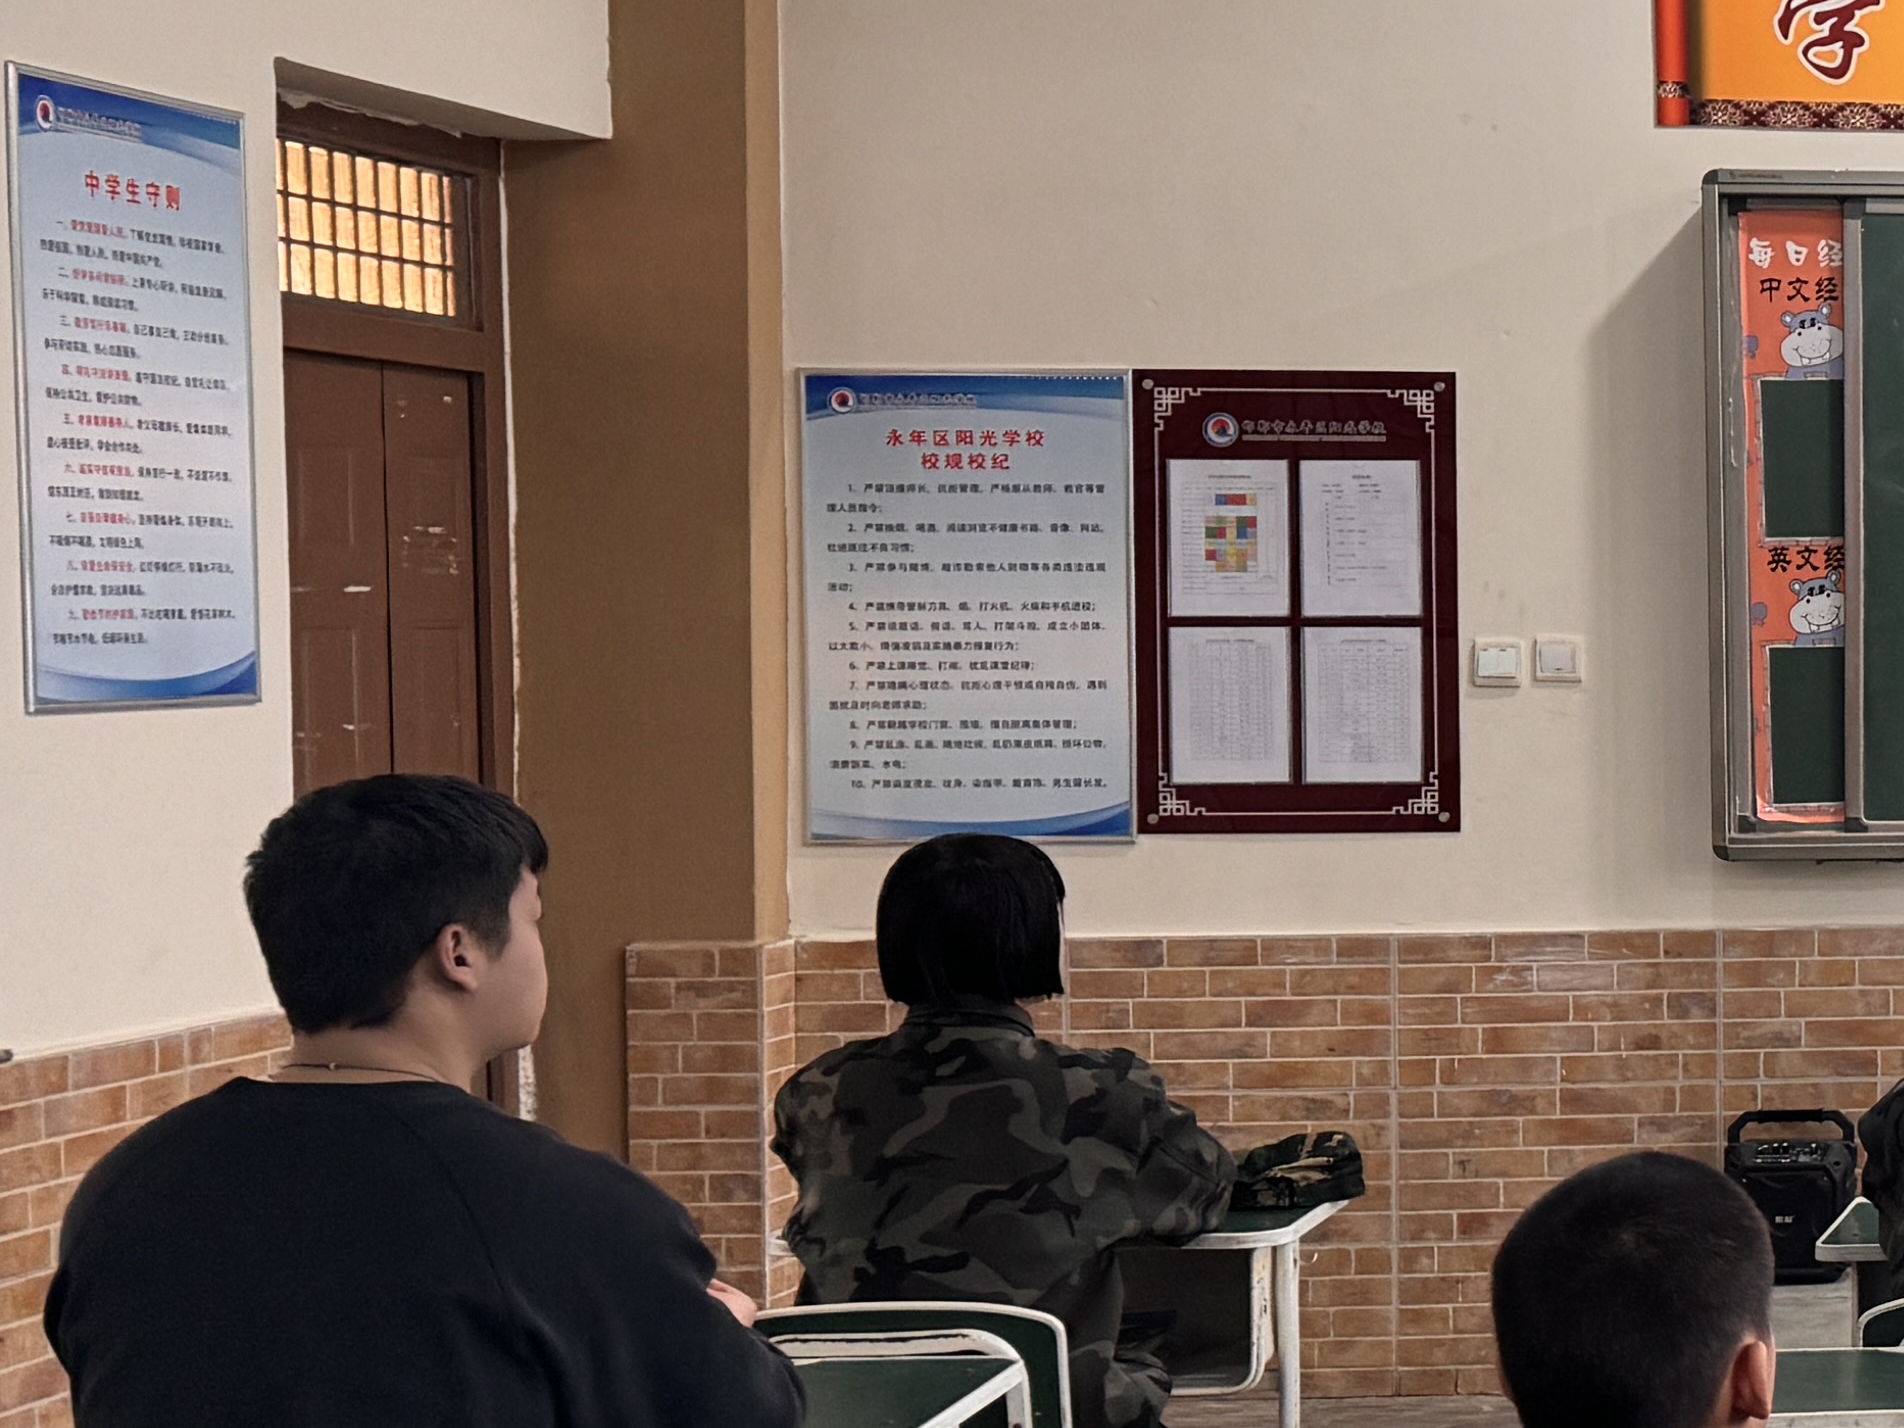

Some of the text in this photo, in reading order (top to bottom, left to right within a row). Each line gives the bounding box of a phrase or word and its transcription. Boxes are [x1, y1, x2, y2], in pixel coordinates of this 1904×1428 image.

[84, 170, 181, 212] 中学生守则
[1759, 276, 1840, 303] 中文经
[886, 428, 1045, 447] 永年区阳光学校
[920, 452, 1011, 470] 校规校纪
[1767, 545, 1844, 572] 英文经
